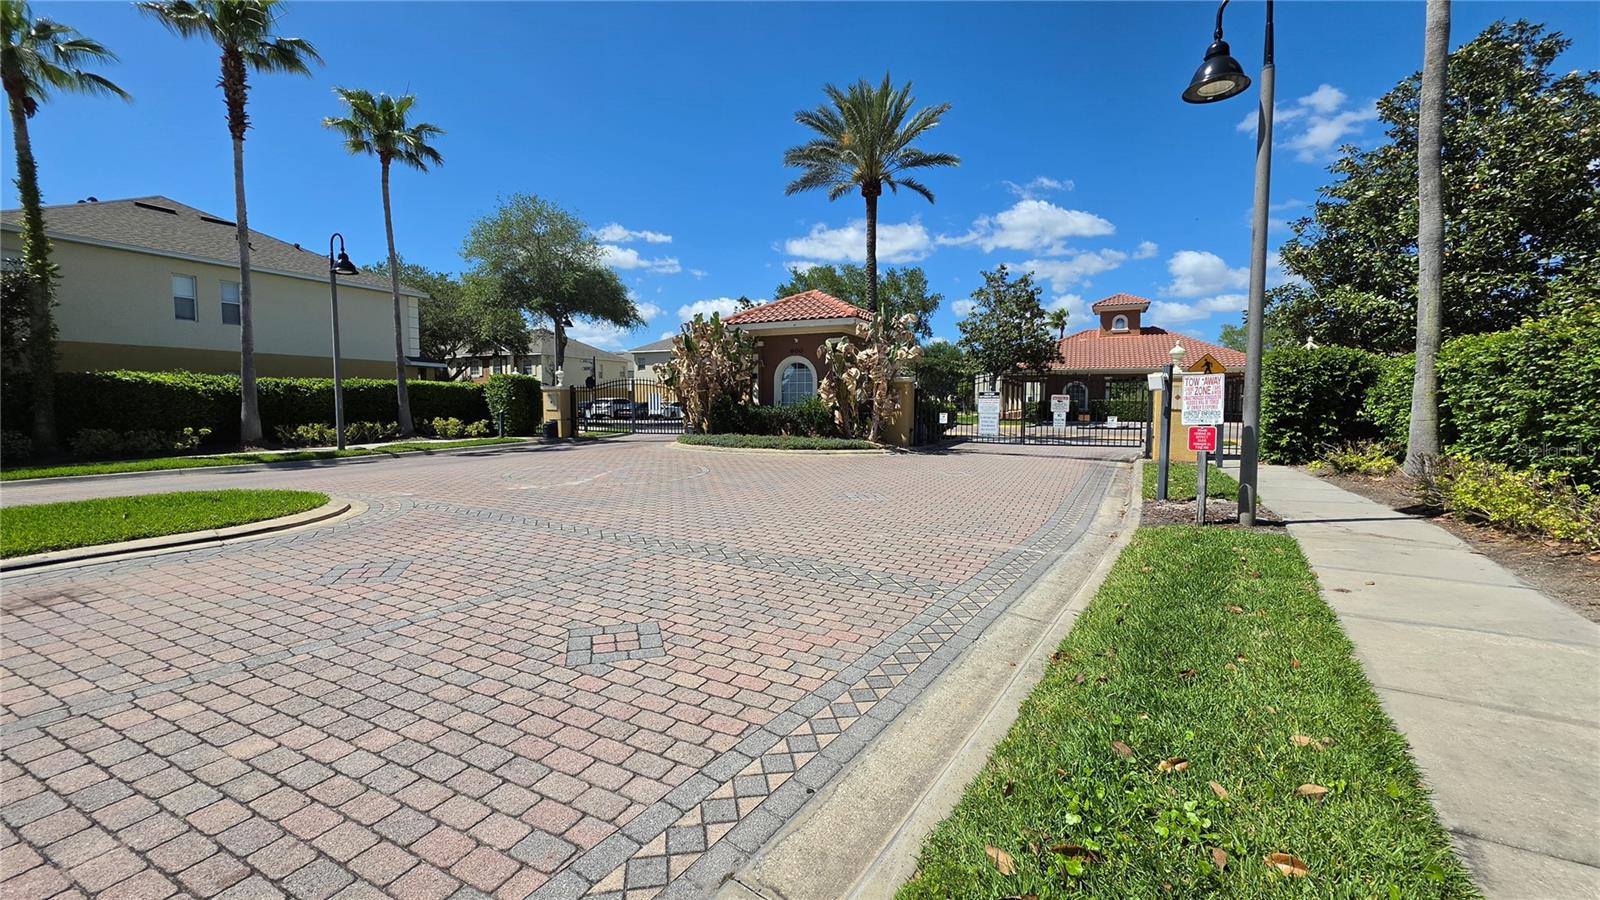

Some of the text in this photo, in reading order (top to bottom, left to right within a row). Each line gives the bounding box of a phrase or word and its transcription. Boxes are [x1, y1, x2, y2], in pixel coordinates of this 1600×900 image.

[1184, 376, 1222, 387] TOW AWAY
[1194, 385, 1212, 396] ZONE
